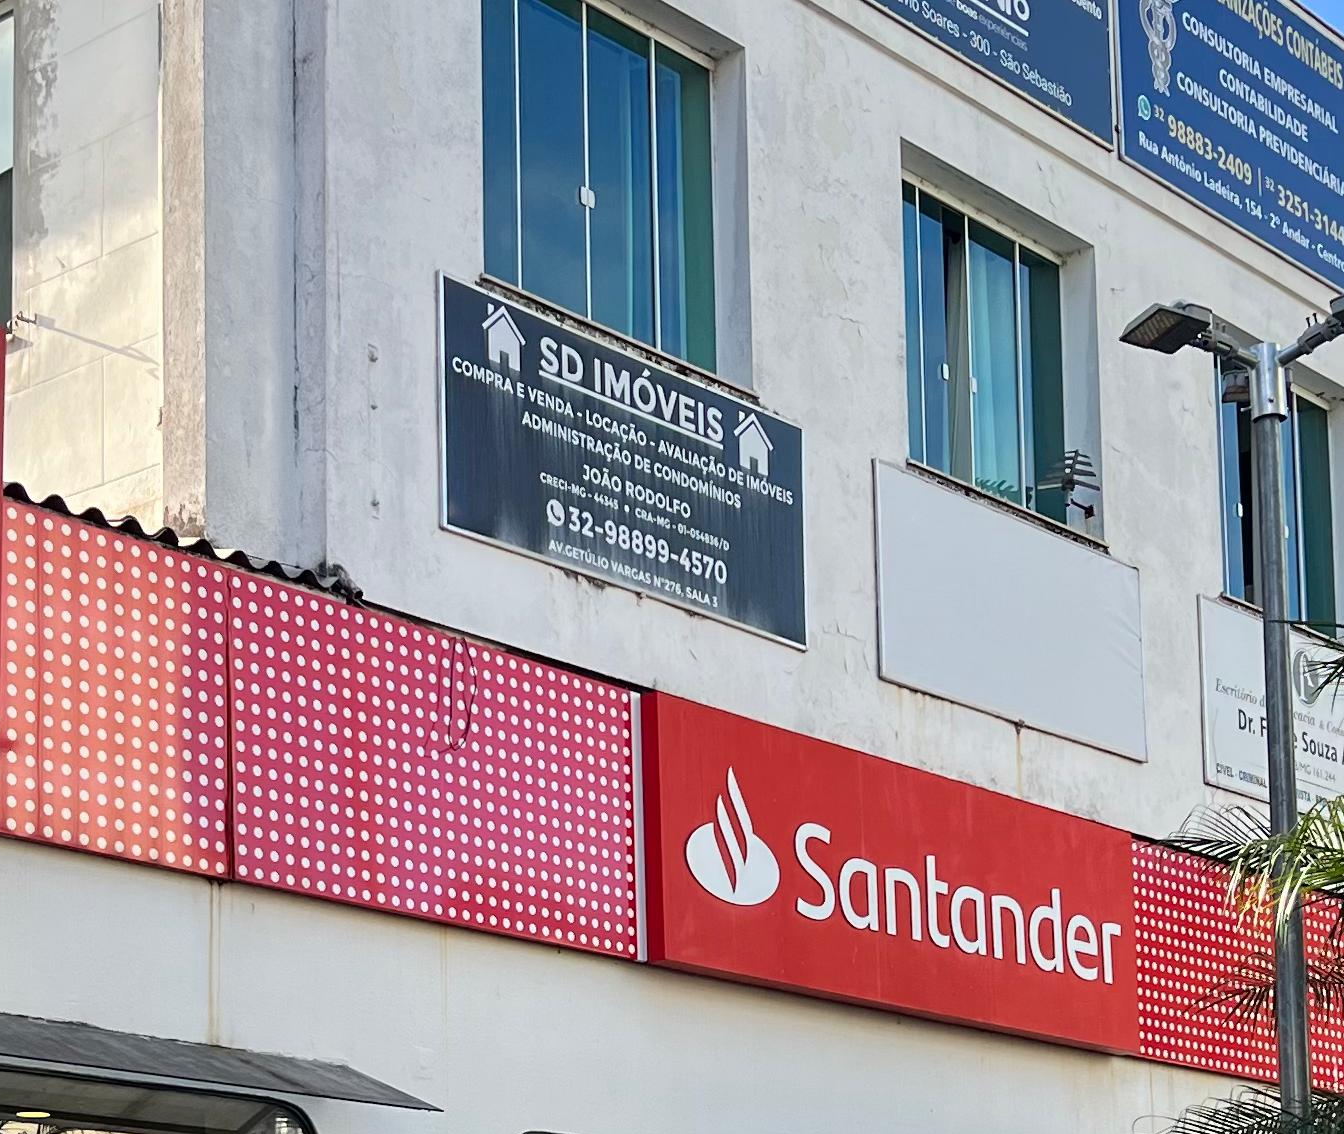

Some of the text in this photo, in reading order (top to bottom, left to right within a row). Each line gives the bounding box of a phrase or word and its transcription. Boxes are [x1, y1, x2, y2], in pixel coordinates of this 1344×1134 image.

[922, 1, 960, 38] Soares
[970, 30, 991, 56] 300
[1000, 49, 1021, 75] São
[1022, 65, 1073, 106] Sebastião
[1182, 12, 1339, 134] CONSULTORIA EMPRESARIAL
[1218, 0, 1344, 90] NIZAÇÕES CONTÁBEIS
[1153, 104, 1165, 122] 32
[1167, 115, 1252, 185] 98883-2409
[1264, 176, 1275, 192] 32
[1176, 72, 1257, 138] CONSULTORIA
[1219, 68, 1308, 142] CONTABILIDADE
[1138, 131, 1158, 155] Rua
[1161, 146, 1202, 183] Antônio
[1204, 171, 1242, 210] Ladeira,
[1245, 198, 1262, 220] 154
[1282, 221, 1310, 249] Andar
[452, 356, 794, 506] COMPRA E VENDA LOCAÇÃO AVALIAÇÃO DE IMÓVEIS
[539, 336, 724, 443] SD IMÓVEIS
[521, 411, 742, 509] ADMINISTRAÇÃO DE CONDOMÍNIOS
[539, 472, 587, 498] CRECI-MG
[635, 507, 671, 530] CRA-MG
[582, 464, 691, 519] JOÃO RODOLFO
[568, 506, 728, 585] 32-98899-4570
[610, 559, 652, 585] VARGAS
[686, 587, 711, 606] SALA
[712, 596, 718, 608] 3
[1238, 708, 1256, 735] Dr.
[1302, 732, 1338, 763] Souza
[794, 821, 1122, 985] Santander
